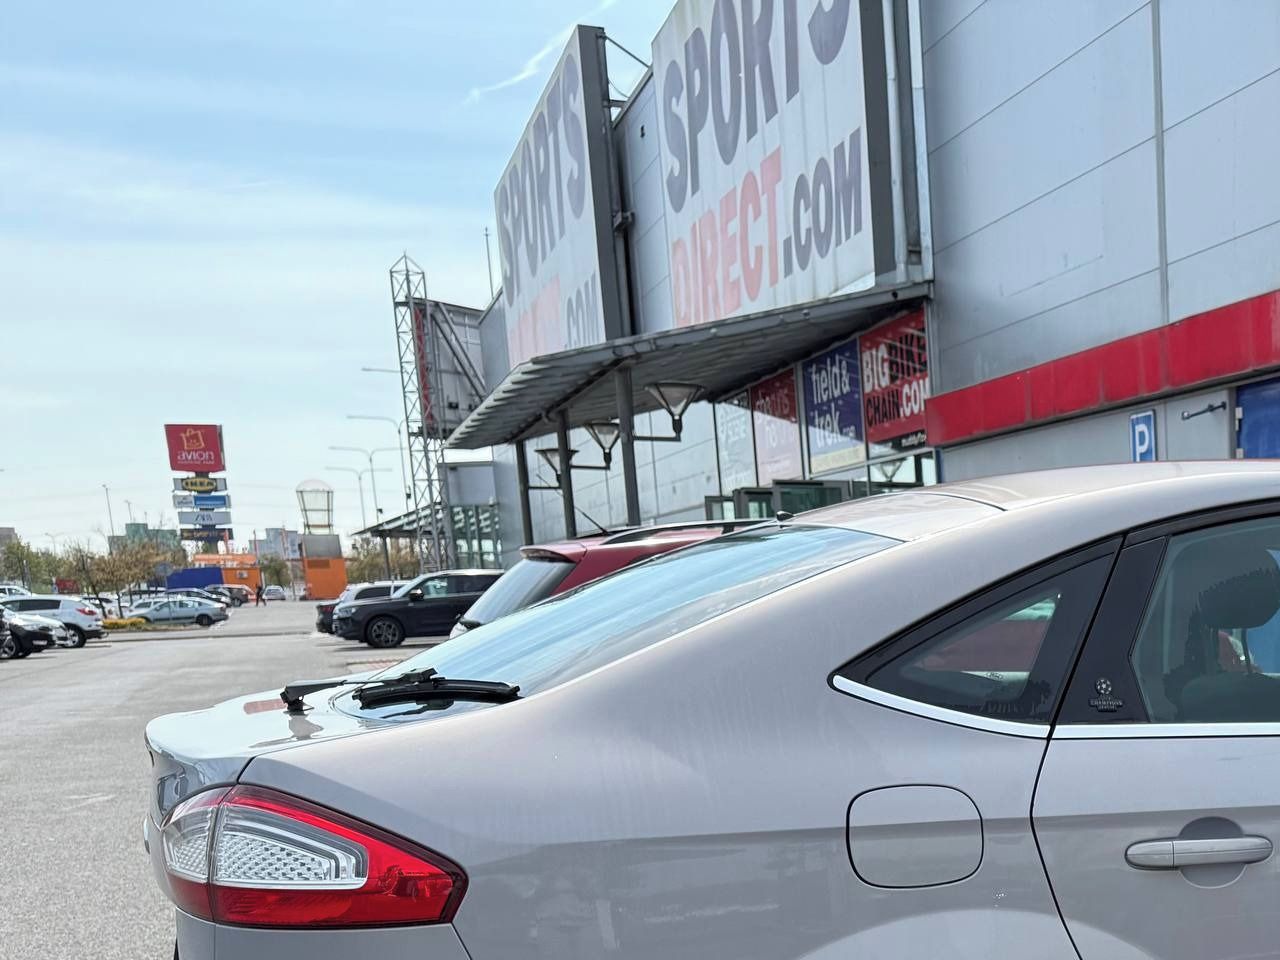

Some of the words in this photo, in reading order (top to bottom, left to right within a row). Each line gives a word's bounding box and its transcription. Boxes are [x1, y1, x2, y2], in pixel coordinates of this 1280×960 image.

[501, 53, 587, 307] SPORTS
[813, 401, 840, 449] trek
[1135, 423, 1149, 462] P
[177, 450, 214, 460] avion
